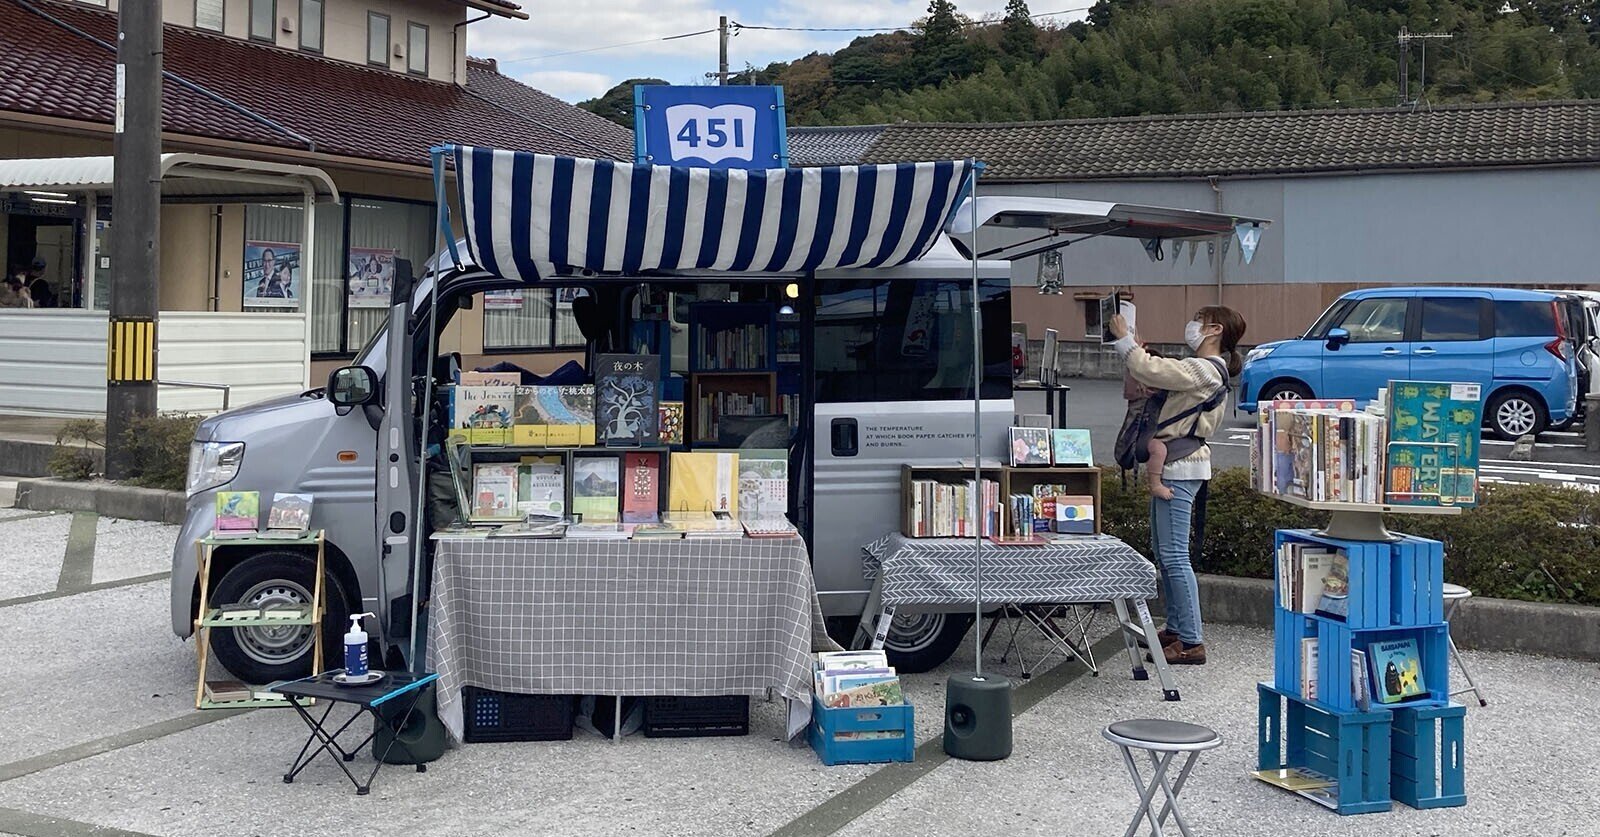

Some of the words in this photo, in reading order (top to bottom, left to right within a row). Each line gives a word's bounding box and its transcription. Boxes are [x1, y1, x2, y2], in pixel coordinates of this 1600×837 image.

[677, 118, 744, 148] 451
[1242, 229, 1256, 250] 4
[612, 360, 644, 371] 夜の木
[1421, 402, 1441, 481] WATER
